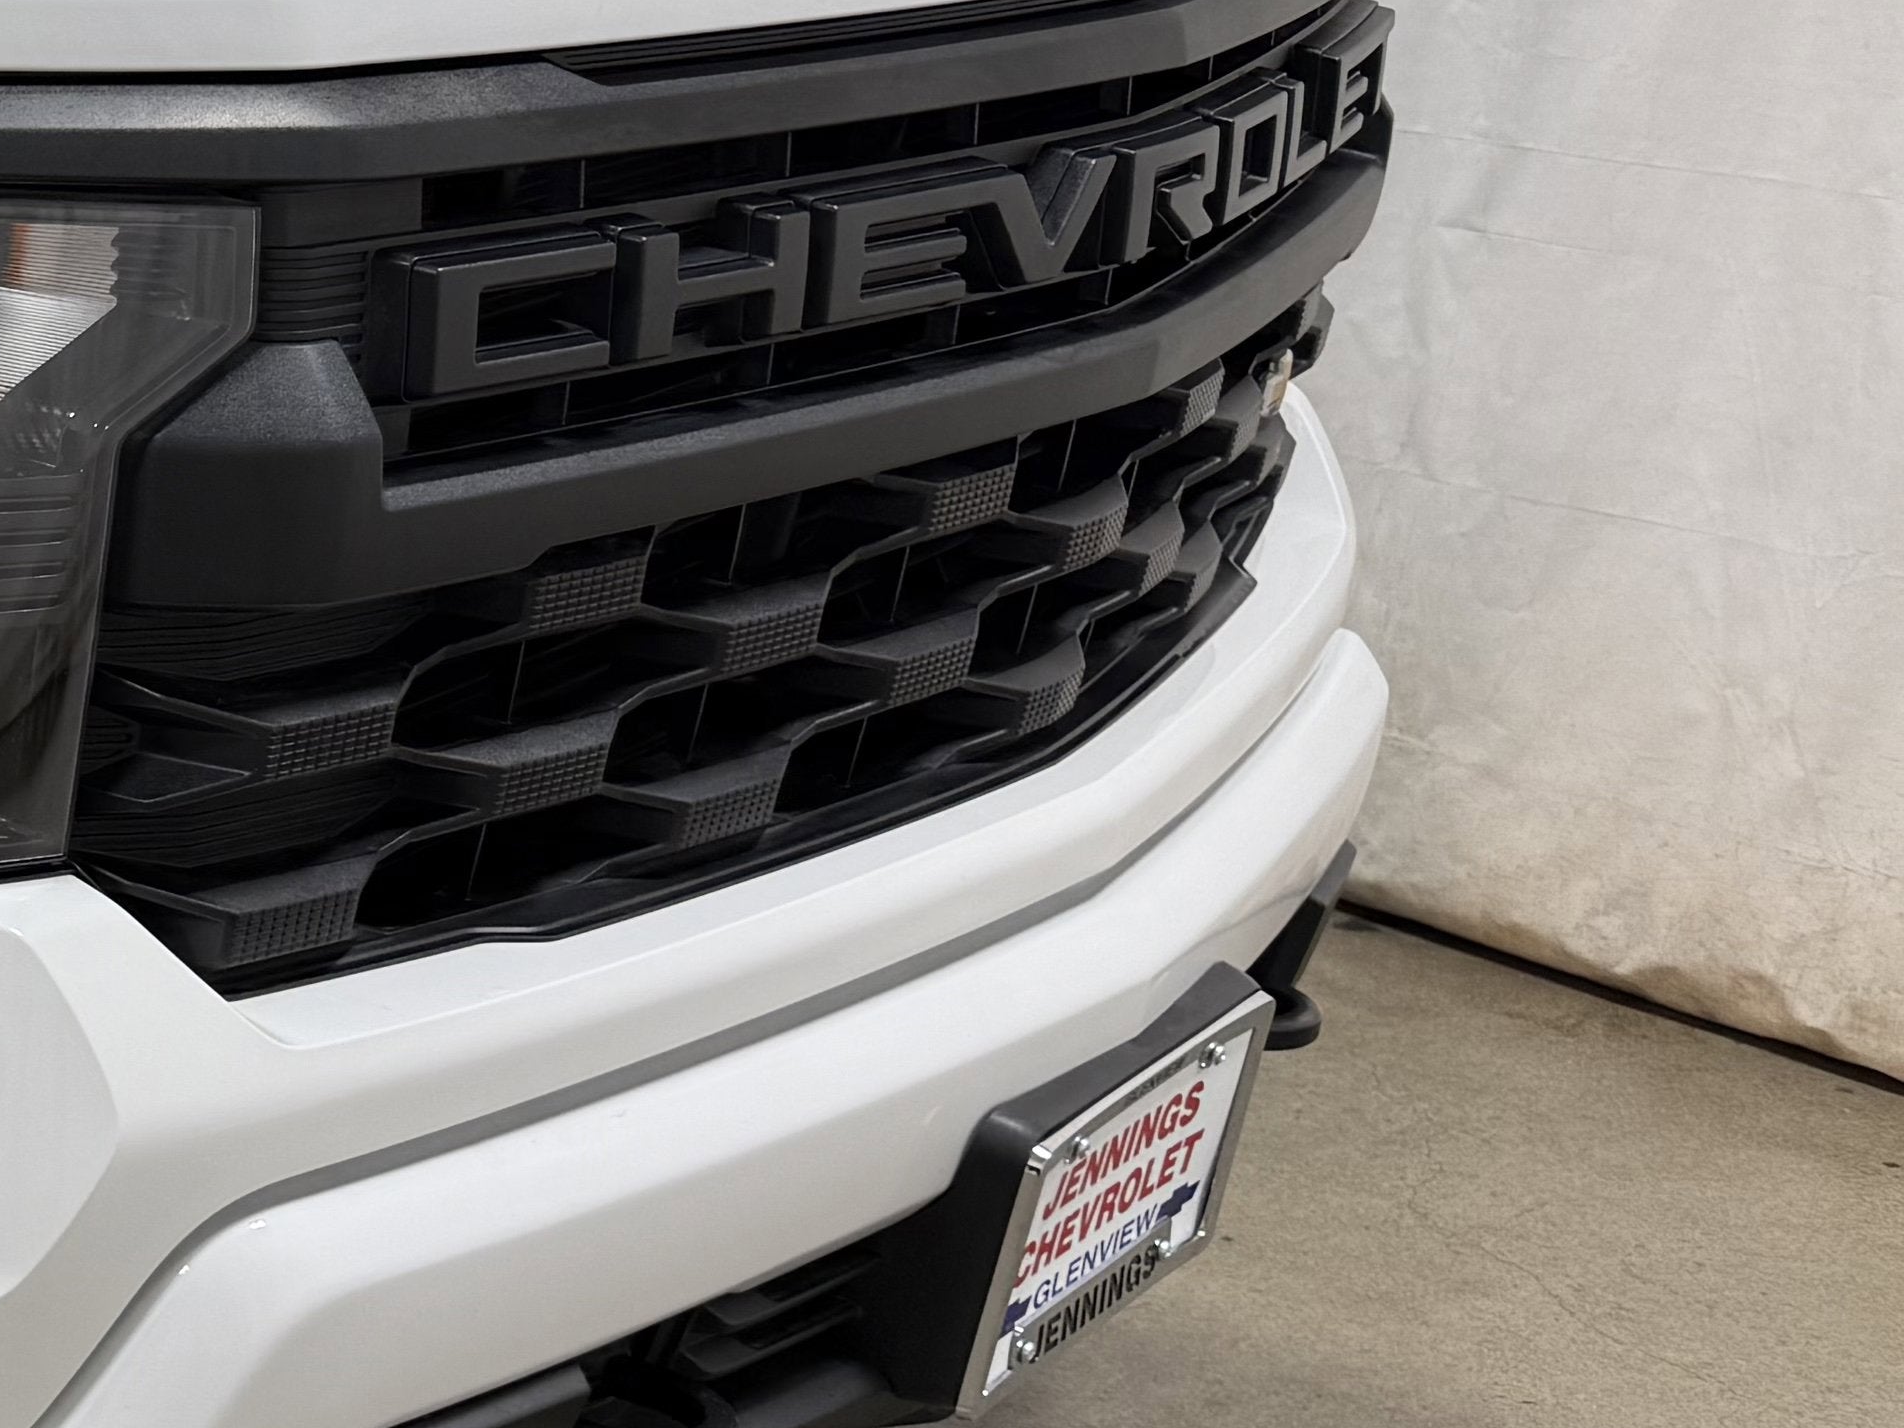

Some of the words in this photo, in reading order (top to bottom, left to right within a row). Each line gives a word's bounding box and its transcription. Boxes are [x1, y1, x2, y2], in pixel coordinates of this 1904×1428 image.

[1013, 1128, 1205, 1289] CHEVROLET
[1042, 1080, 1205, 1221] JENNINGS
[1028, 1244, 1162, 1365] JENNINGS
[1033, 1203, 1159, 1310] GLENVIEW
